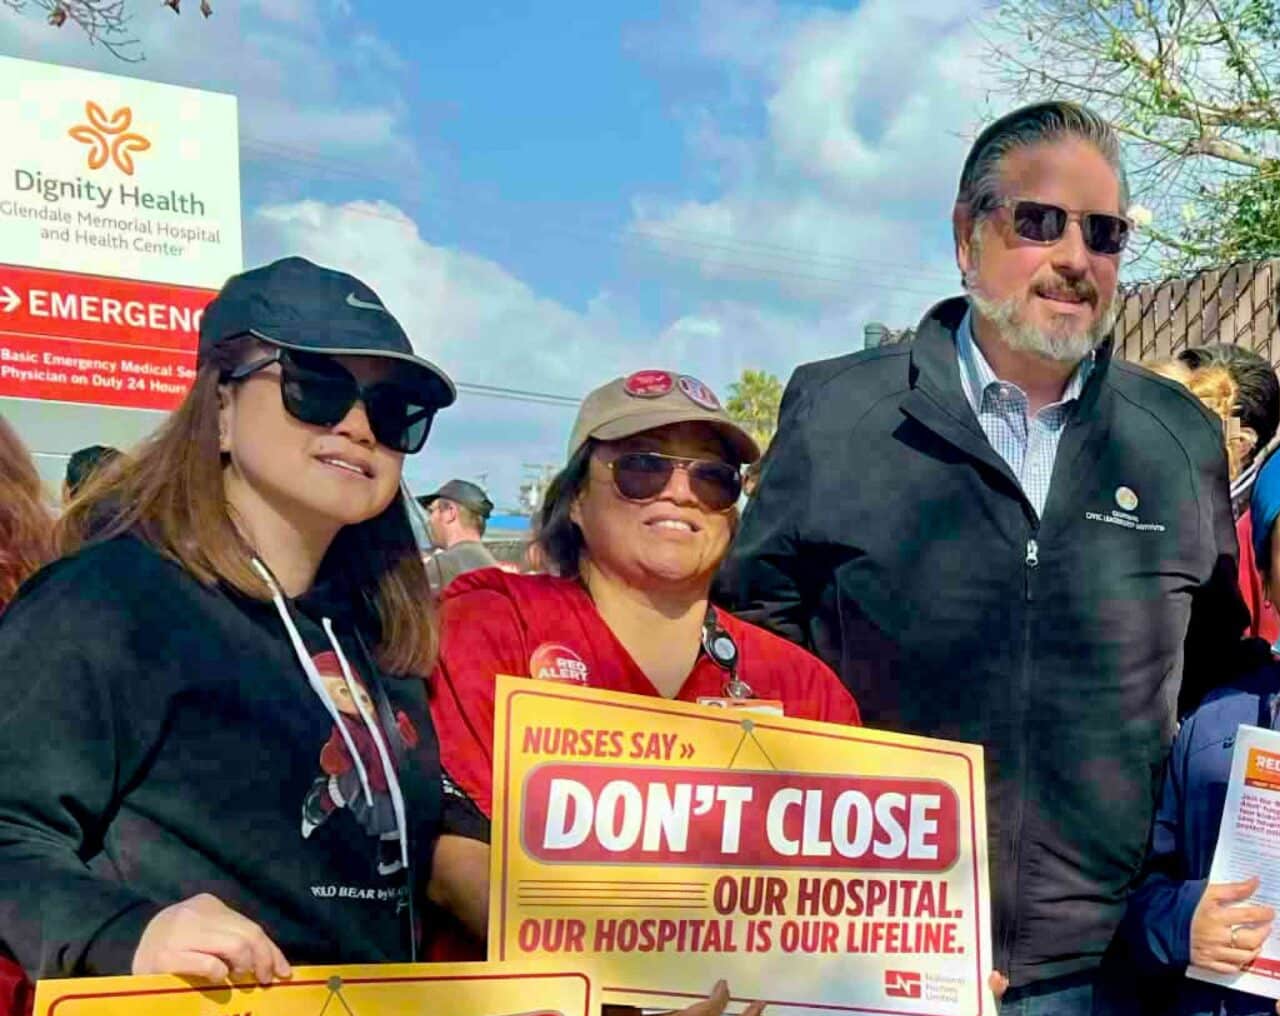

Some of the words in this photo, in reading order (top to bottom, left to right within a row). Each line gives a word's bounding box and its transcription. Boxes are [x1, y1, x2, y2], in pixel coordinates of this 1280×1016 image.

[15, 169, 112, 208] Dignity
[120, 184, 204, 216] Health
[0, 202, 72, 223] Glendale
[78, 211, 151, 234] Memorial
[157, 223, 220, 244] Hospital
[41, 227, 69, 242] and
[75, 231, 129, 250] Health
[133, 238, 185, 256] Center
[0, 348, 38, 363] Basic
[43, 352, 117, 372] Emergency
[121, 360, 172, 377] Medical
[0, 365, 67, 384] Physician
[71, 374, 88, 384] on
[92, 374, 123, 390] Duty
[127, 378, 145, 390] 24
[538, 667, 587, 681] ALERT
[556, 657, 586, 671] RED
[523, 726, 625, 759] NURSES
[543, 778, 753, 855] DON'T
[766, 788, 941, 860] CLOSE
[339, 887, 376, 899] BEAR
[713, 876, 786, 916] OUR
[797, 879, 963, 918] HOSPITAL.
[519, 919, 585, 953] OUR
[594, 919, 738, 953] HOSPITAL
[746, 922, 771, 953] IS
[780, 922, 838, 953] OUR
[846, 922, 964, 954] LIFELINE.
